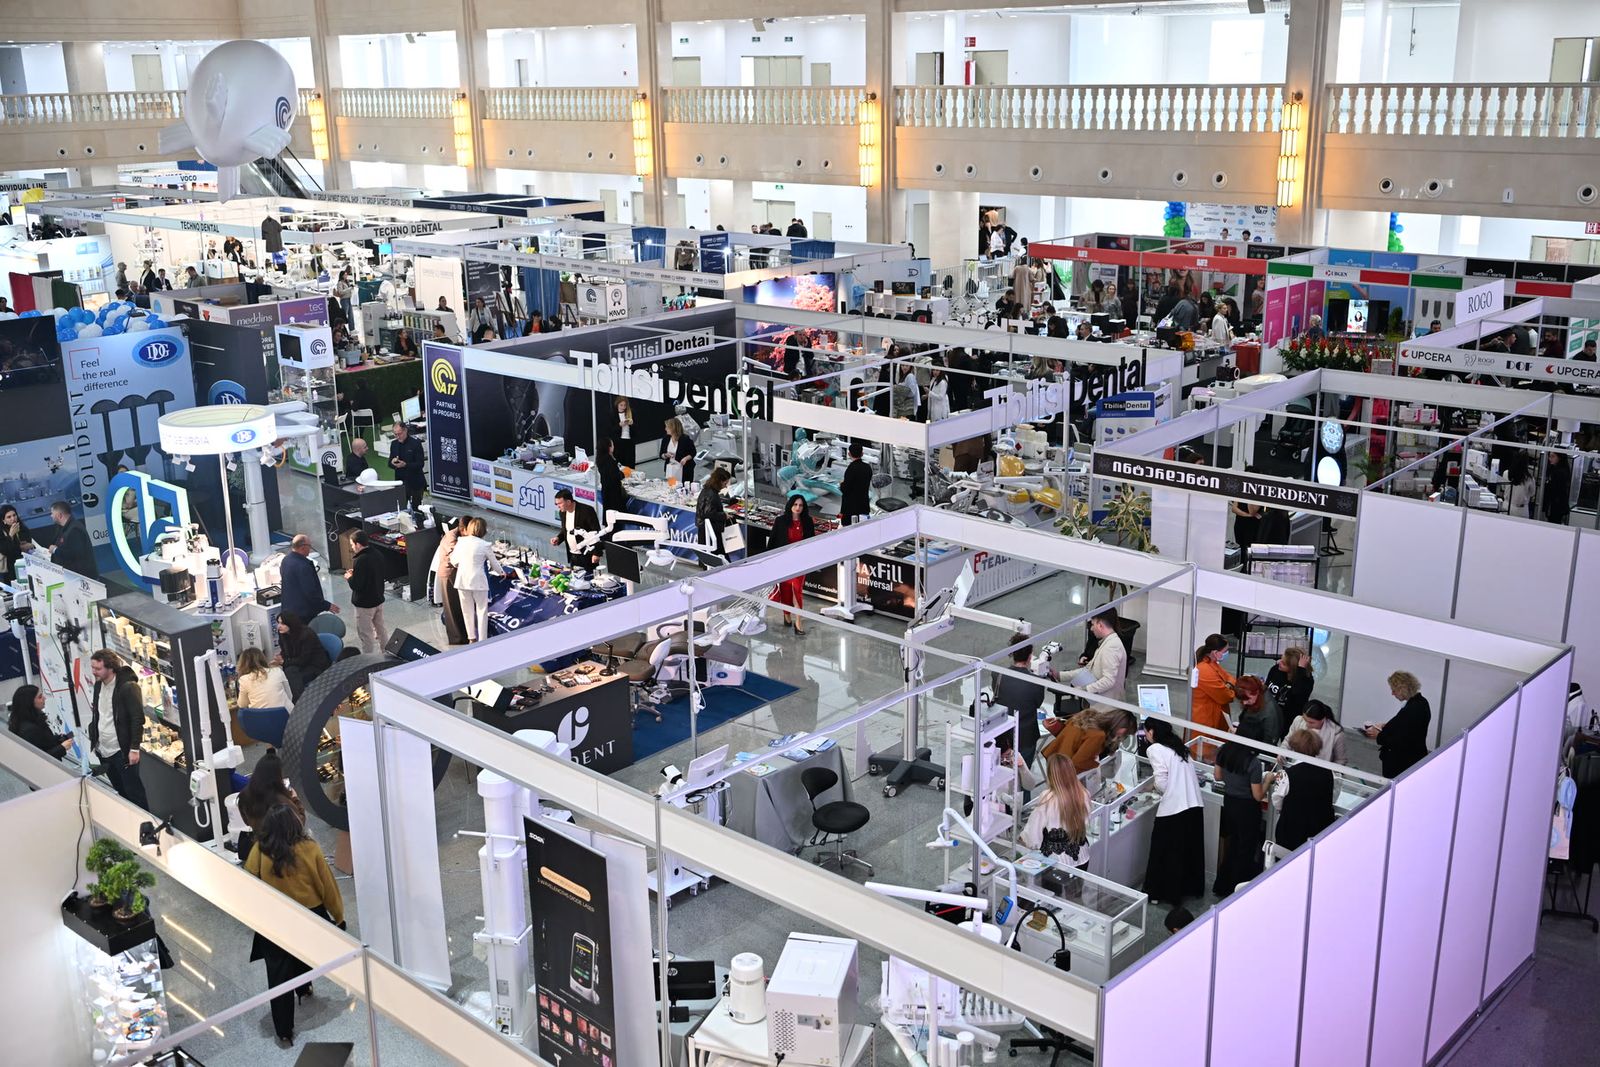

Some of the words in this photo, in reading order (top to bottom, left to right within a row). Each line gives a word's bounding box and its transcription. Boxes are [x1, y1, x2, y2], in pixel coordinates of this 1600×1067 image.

[181, 221, 200, 231] TECHNO
[201, 224, 219, 233] DENTAL
[374, 226, 409, 237] TECHNO
[411, 222, 443, 234] DENTAL
[1468, 291, 1493, 314] ROGO
[236, 312, 273, 326] meddins
[613, 341, 660, 362] Tbilisi
[80, 358, 100, 368] Feel
[1411, 351, 1452, 363] UPCERA
[1556, 366, 1600, 380] UPCERA
[82, 372, 98, 380] the
[99, 368, 116, 378] real
[1069, 348, 1148, 404] Dental
[84, 378, 129, 392] difference
[439, 383, 458, 396] A17
[569, 349, 665, 403] Tbilisi
[663, 369, 774, 422] Dental
[436, 400, 457, 409] PARTNER
[438, 410, 461, 419] PROGRESS
[1242, 480, 1329, 507] INTERDENT
[93, 530, 110, 540] Qua
[804, 581, 818, 590] Hybrid
[857, 576, 894, 591] universal
